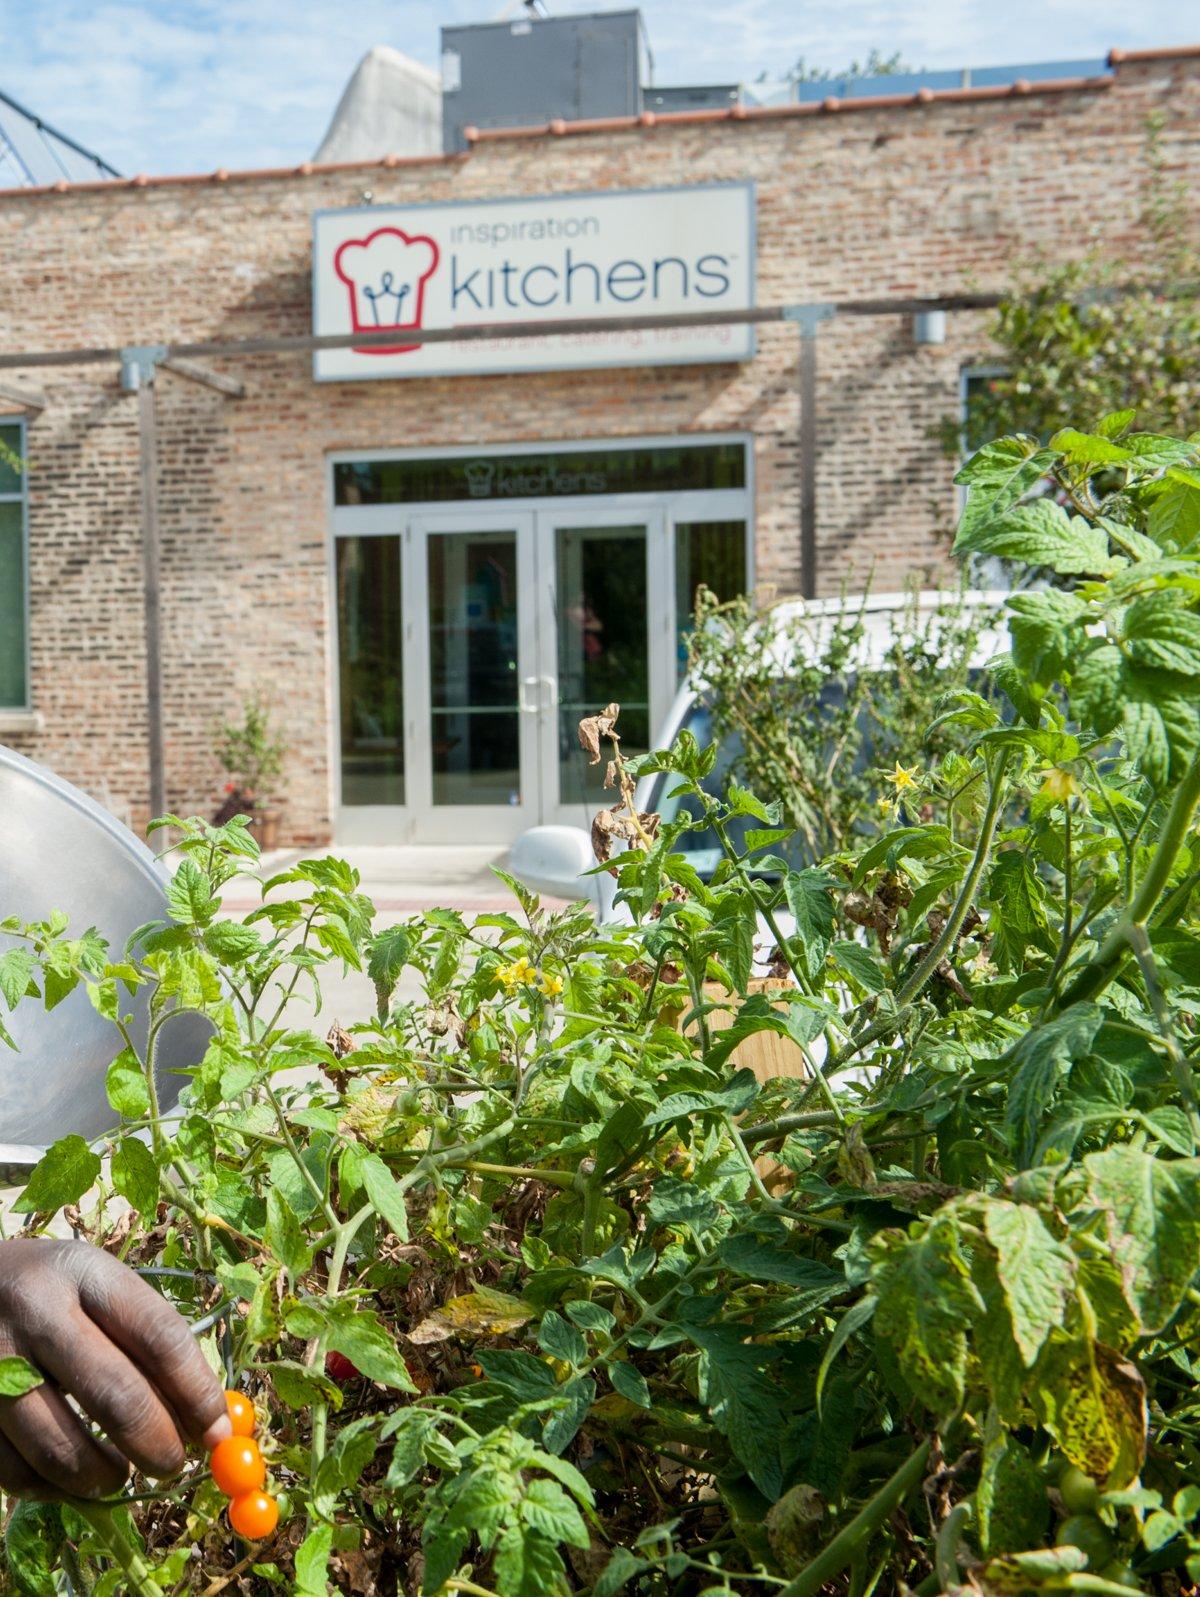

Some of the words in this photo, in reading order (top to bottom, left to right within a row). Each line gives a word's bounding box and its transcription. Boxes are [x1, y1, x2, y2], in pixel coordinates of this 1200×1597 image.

[450, 216, 600, 246] inspiration
[451, 247, 730, 310] kitchens
[499, 468, 607, 494] kitchens
